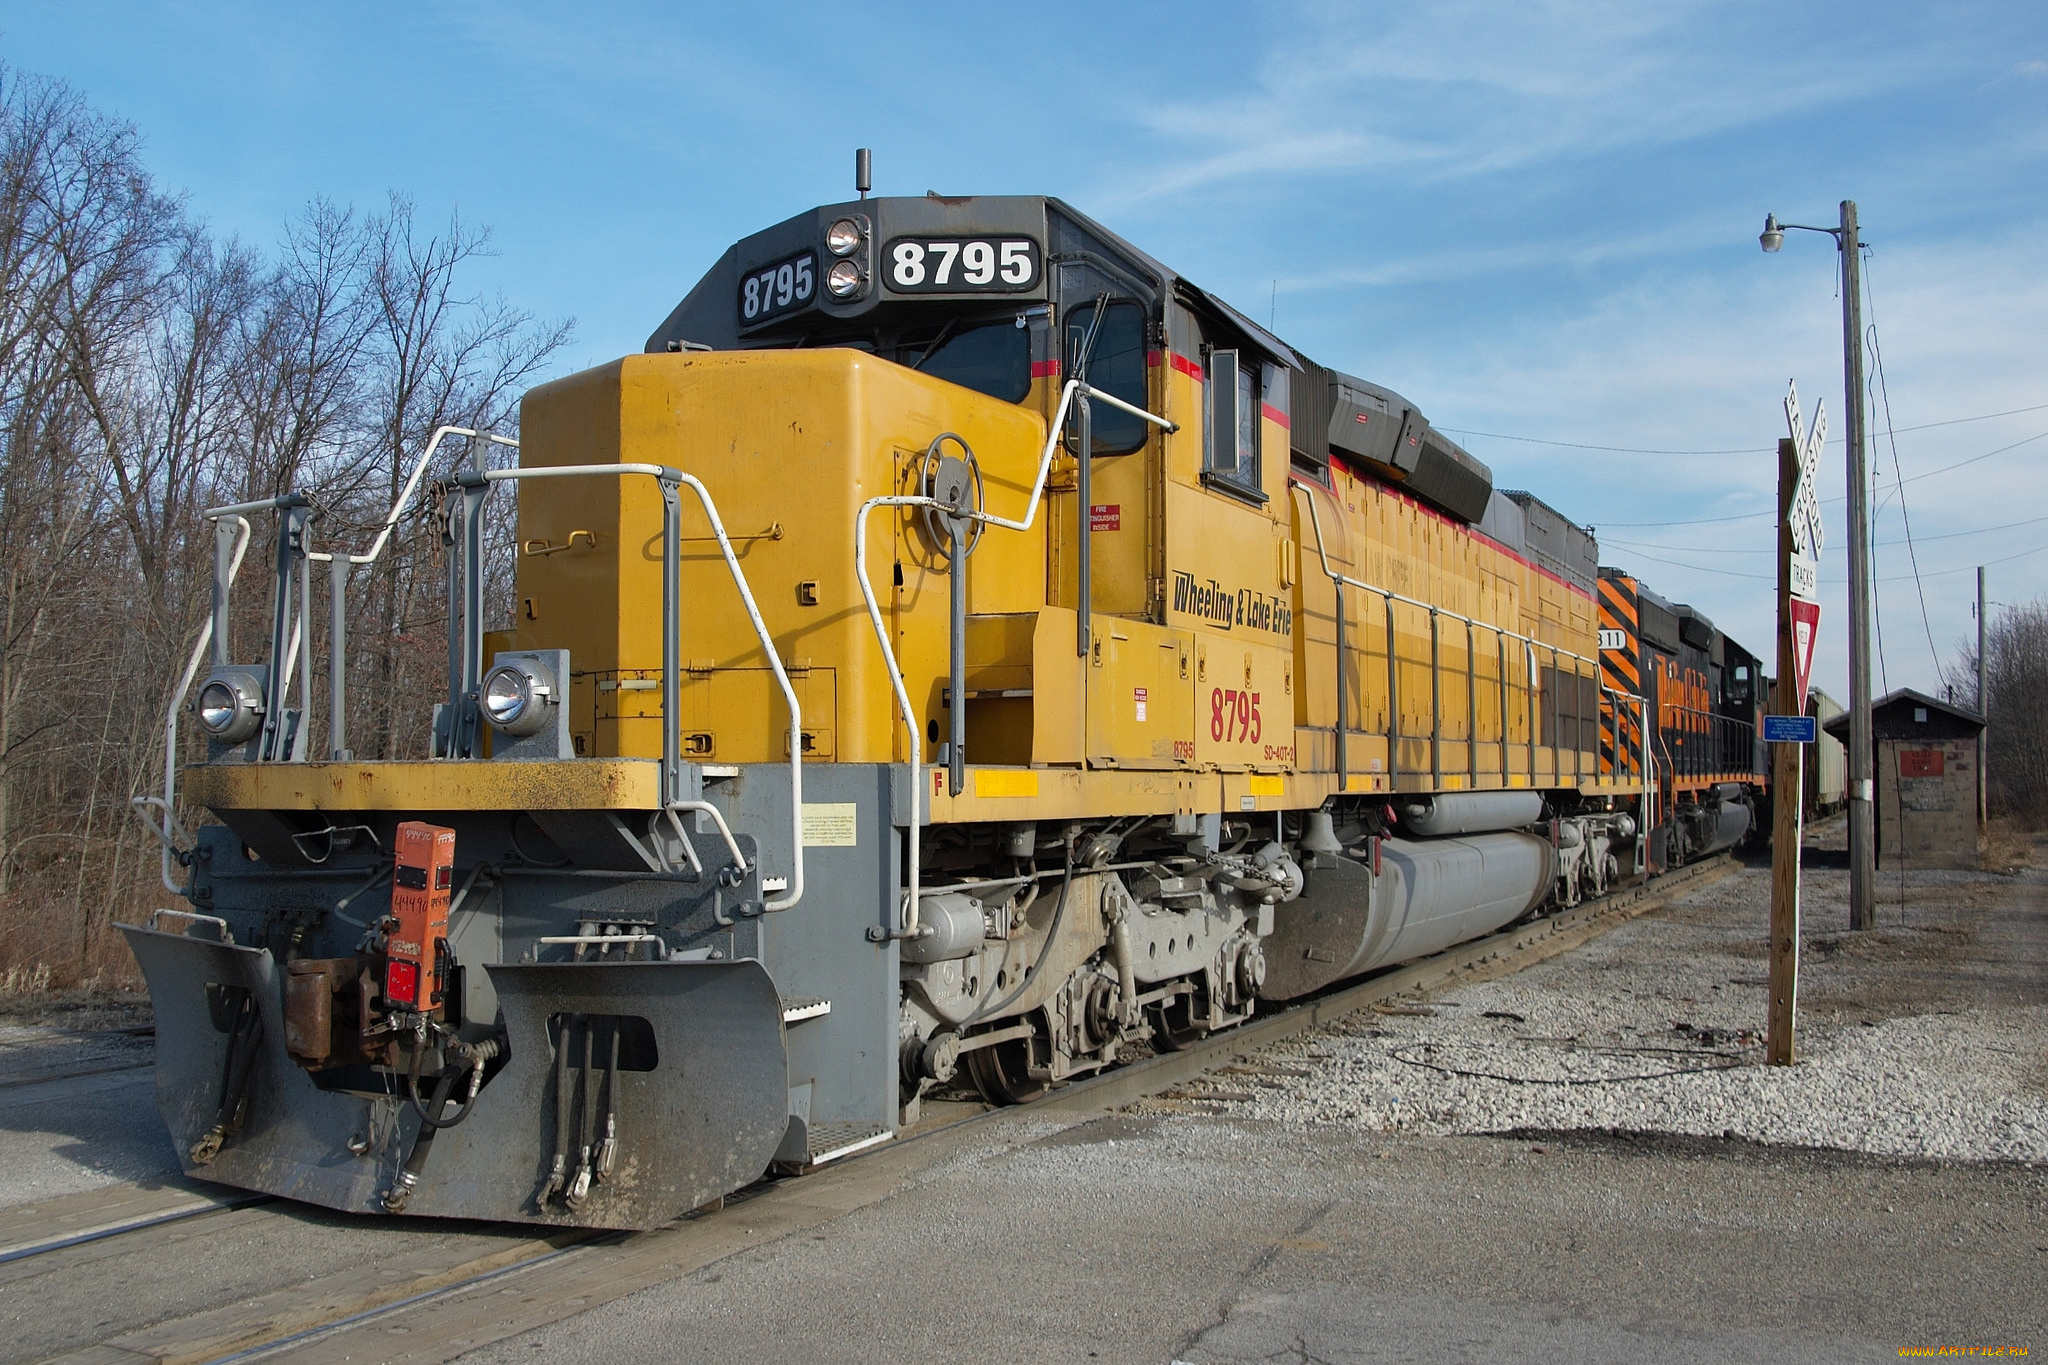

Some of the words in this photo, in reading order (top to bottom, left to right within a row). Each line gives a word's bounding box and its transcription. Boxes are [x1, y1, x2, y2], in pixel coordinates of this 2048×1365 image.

[892, 241, 1032, 286] 8795
[744, 256, 813, 319] 8795
[1792, 409, 1827, 538] CROSSING
[1090, 514, 1120, 522] TINGUISHER
[1095, 505, 1107, 513] FIRE
[1092, 523, 1110, 531] INSIDE
[1801, 524, 1806, 550] 2
[1793, 563, 1814, 588] TRACKS
[1172, 569, 1234, 631] Wheeling
[1236, 588, 1244, 626] &
[1244, 588, 1270, 631] Lake
[1269, 596, 1291, 636] Erie
[1211, 687, 1262, 744] 8795
[1173, 741, 1194, 759] 8795
[1264, 744, 1294, 762] SD-40T-2
[934, 772, 943, 796] F
[394, 894, 429, 914] 44490
